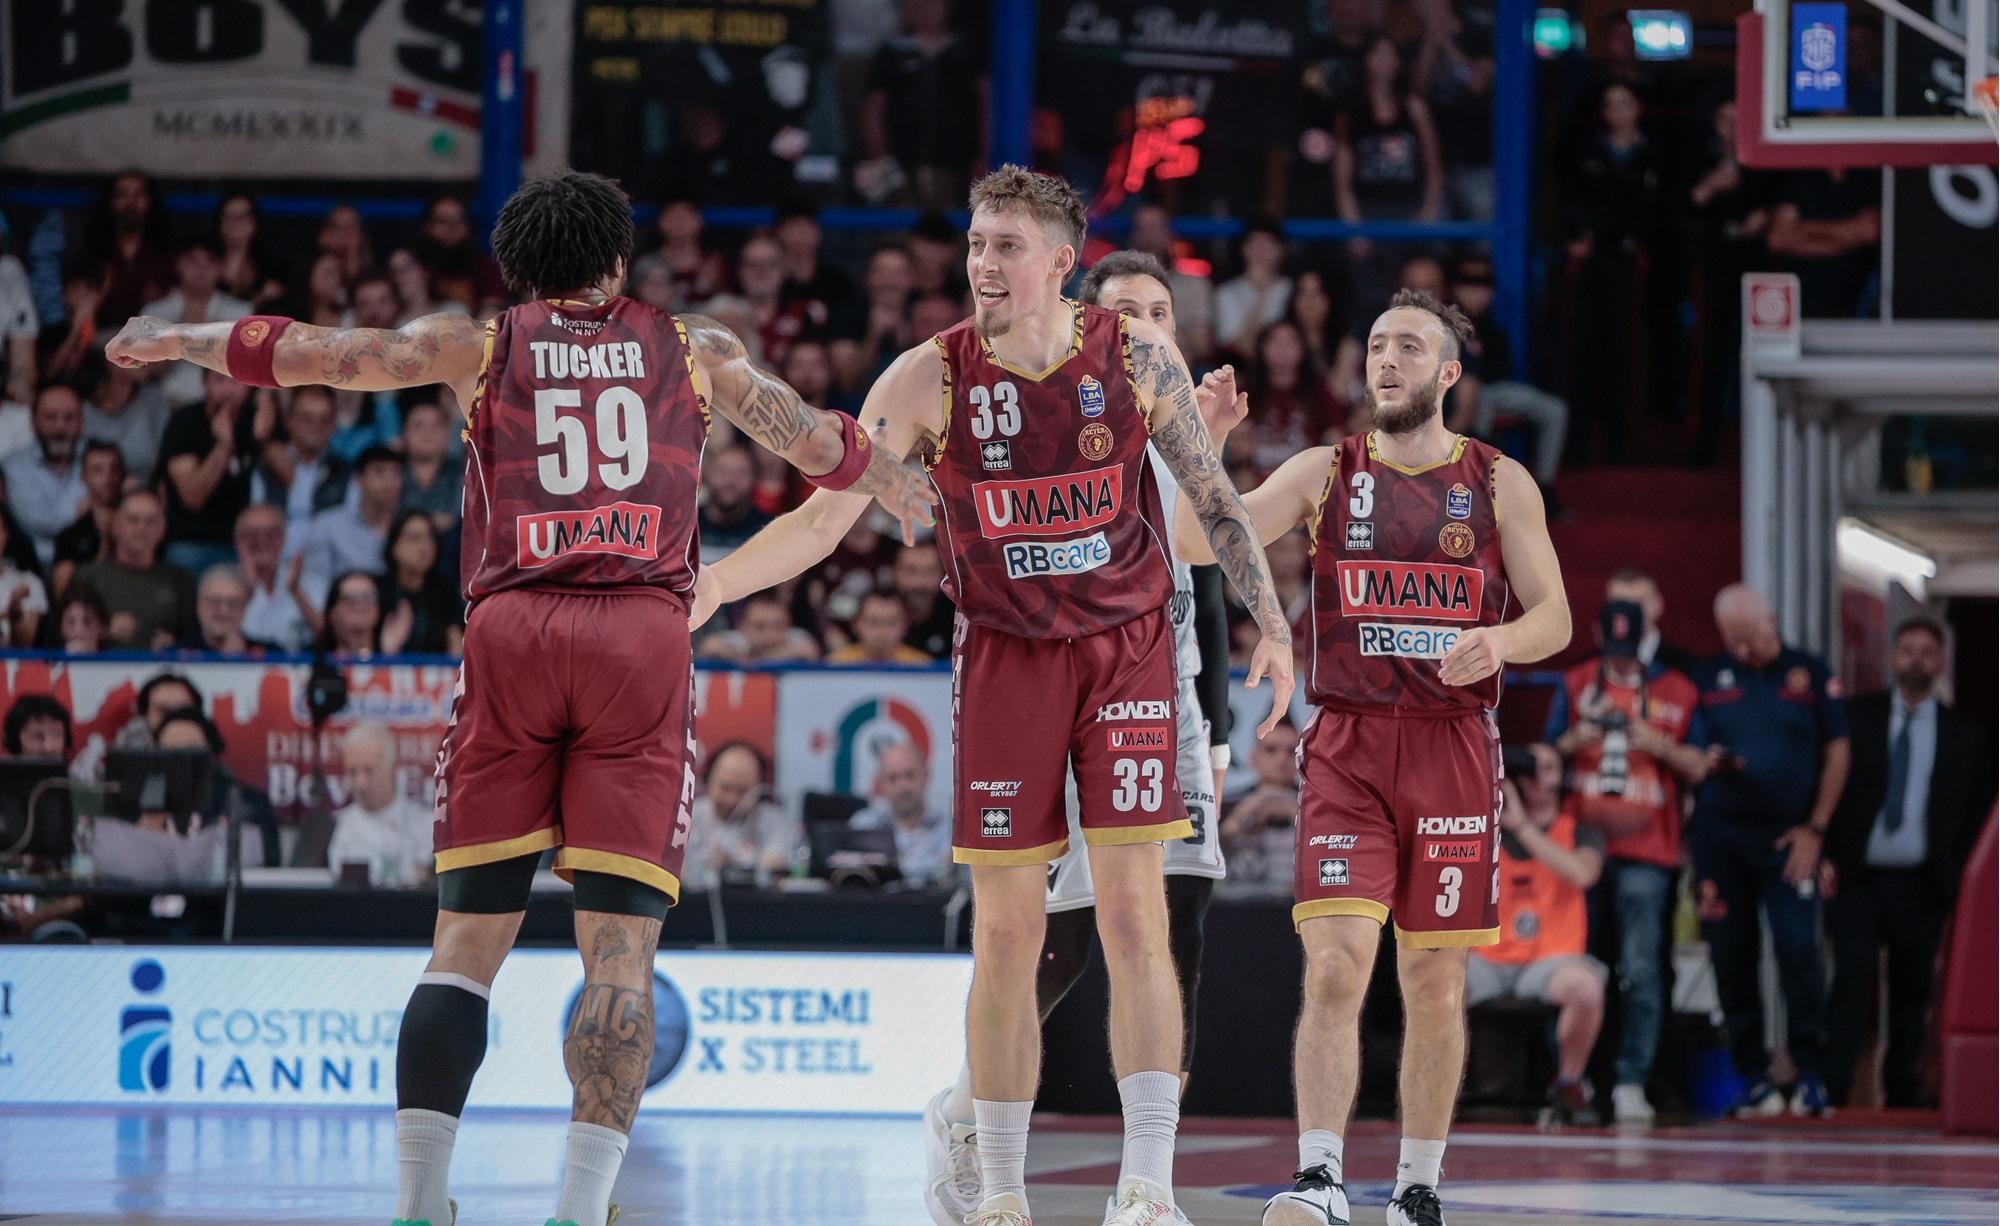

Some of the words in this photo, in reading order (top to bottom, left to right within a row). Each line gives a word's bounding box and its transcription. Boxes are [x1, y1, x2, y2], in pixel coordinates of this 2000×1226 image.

[1796, 71, 1841, 91] FIP
[530, 342, 645, 379] TUCKER
[1083, 391, 1100, 400] LBA
[969, 382, 1021, 439] 33
[534, 386, 648, 495] 59
[1085, 427, 1105, 435] REYER
[984, 459, 1009, 469] errea
[1350, 471, 1375, 518] 3
[1006, 538, 1108, 576] RBcare
[1348, 539, 1370, 548] errea
[1096, 701, 1170, 722] HOWDEN
[1112, 758, 1164, 812] 33
[984, 827, 1009, 835] errea
[1417, 815, 1487, 835] HOWDEN
[1322, 875, 1346, 884] errea
[1435, 866, 1463, 917] 3
[699, 987, 870, 1024] SISTEMI
[698, 1037, 725, 1072] X
[742, 1037, 872, 1072] STEEL
